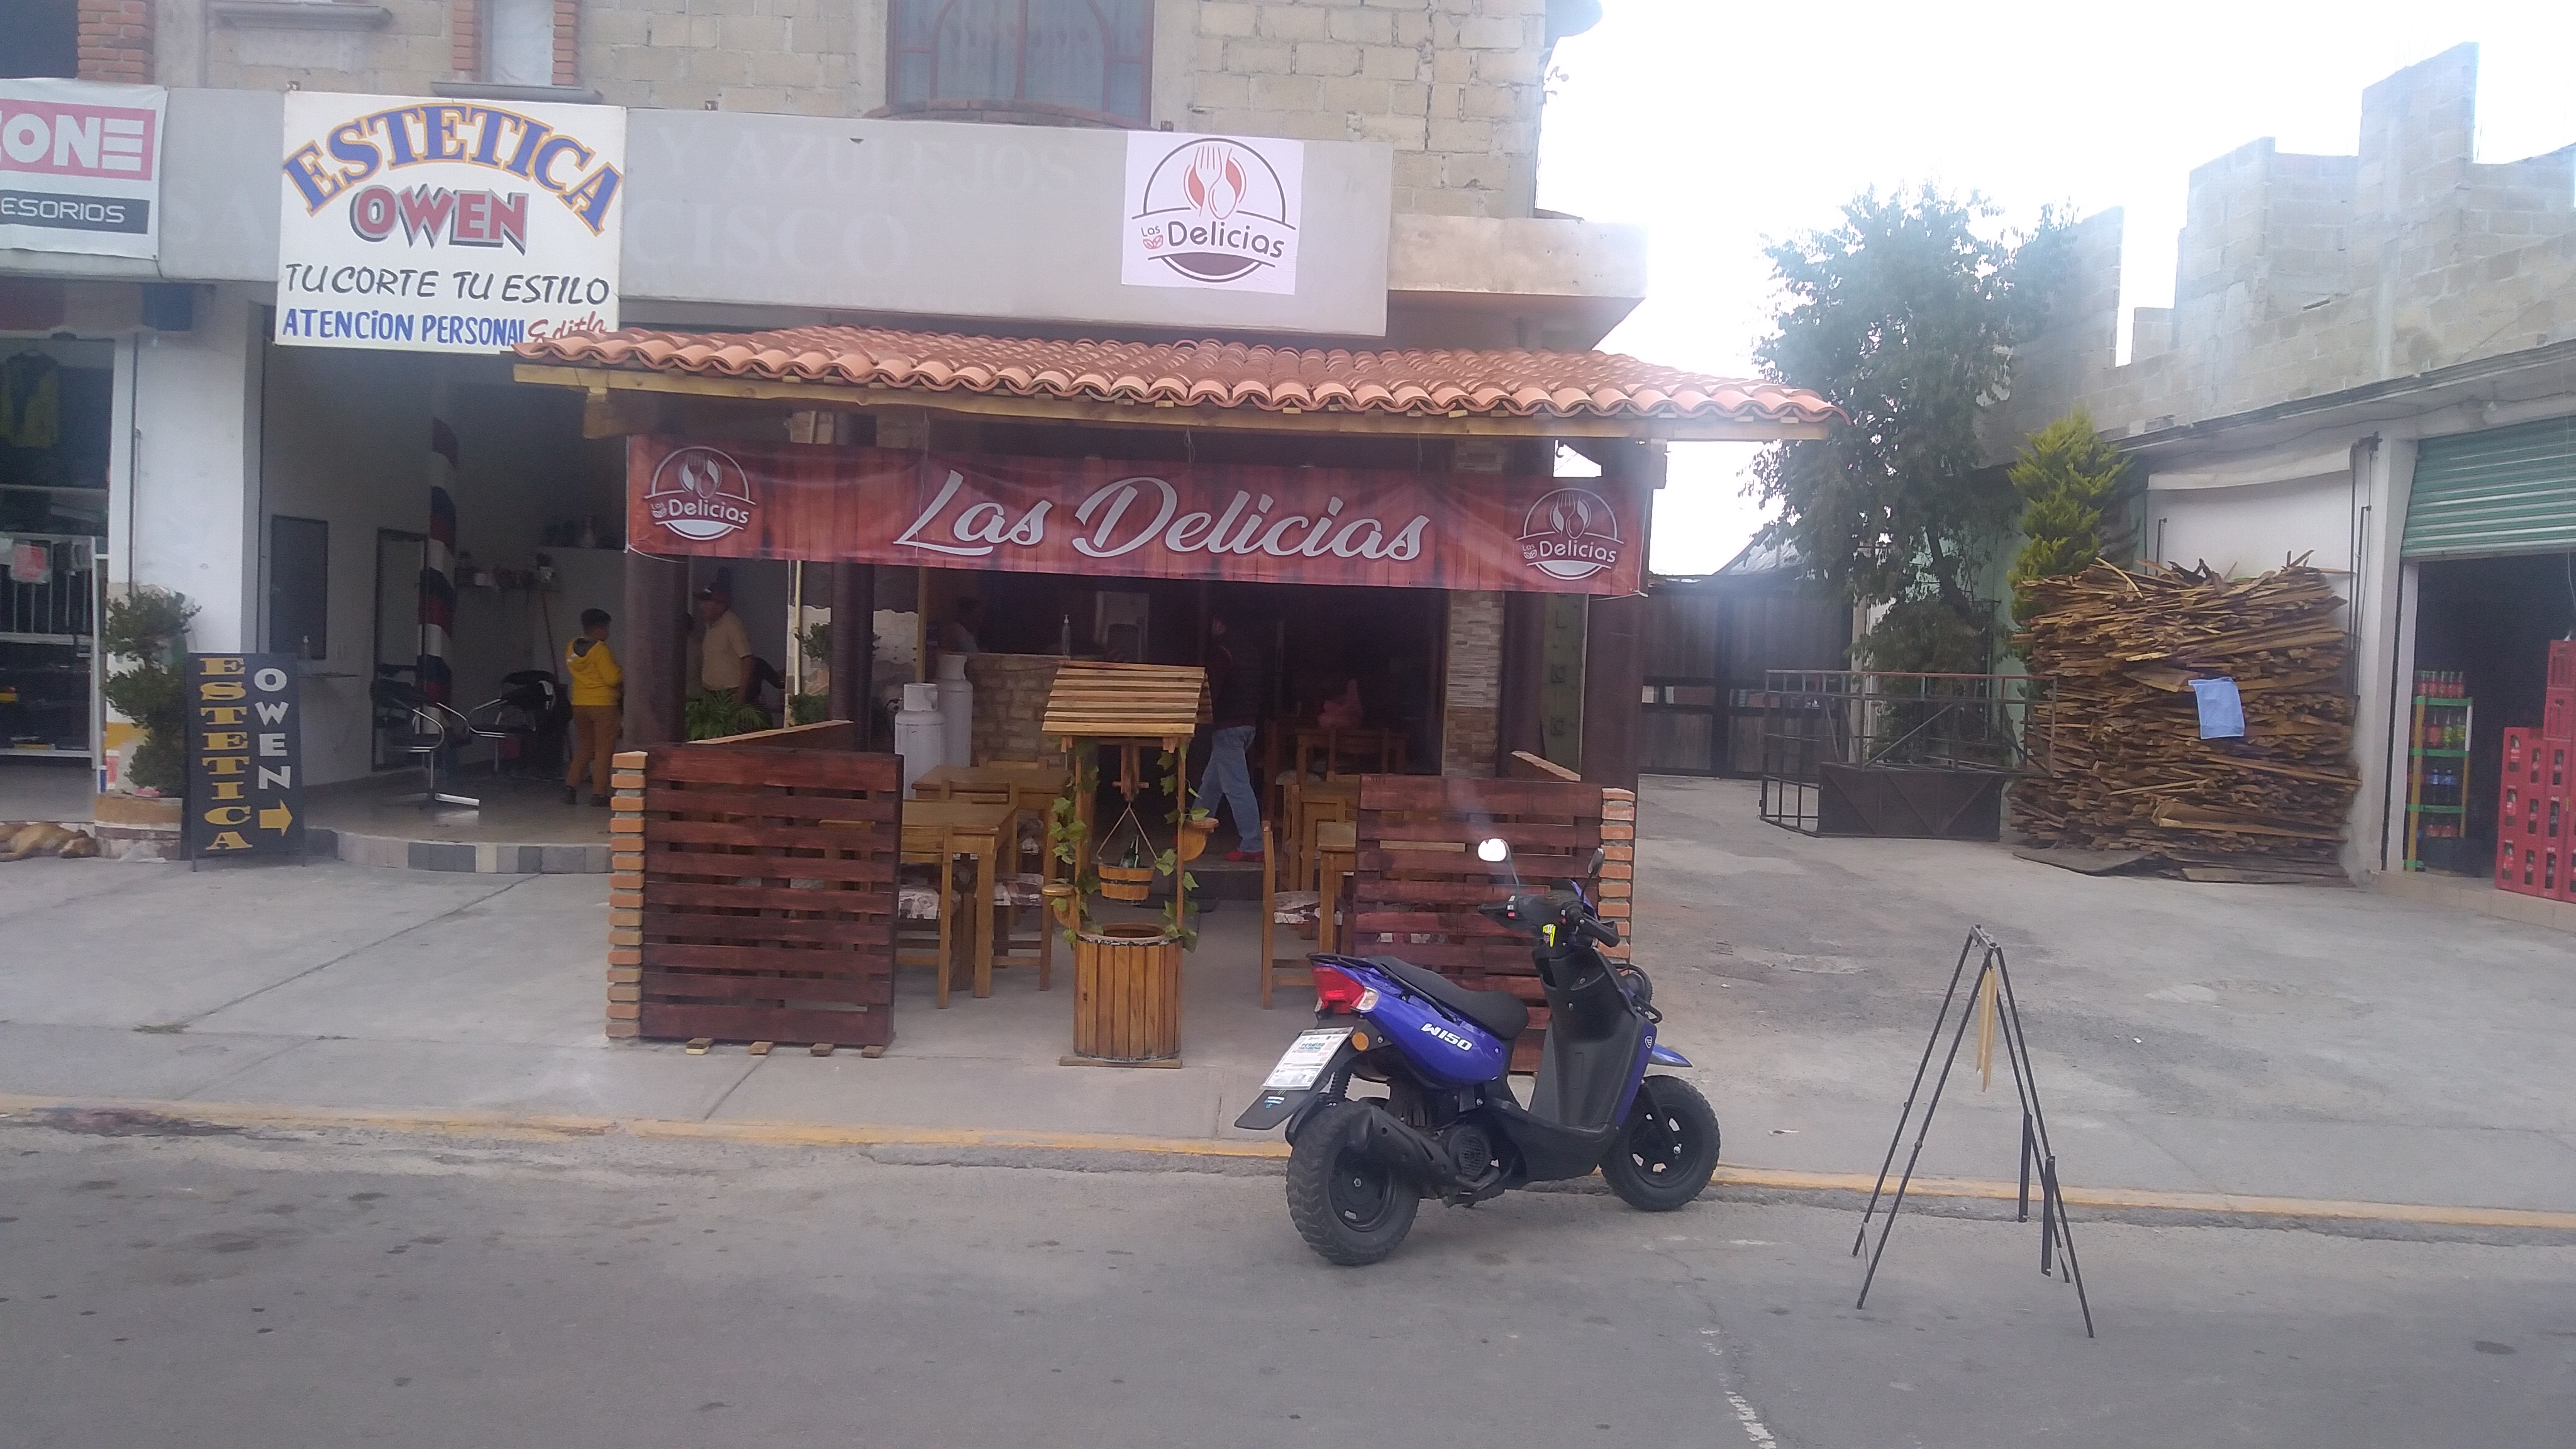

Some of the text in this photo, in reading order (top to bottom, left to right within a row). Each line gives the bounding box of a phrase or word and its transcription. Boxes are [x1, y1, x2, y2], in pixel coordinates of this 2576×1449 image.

[0, 111, 145, 172] ONE
[281, 103, 624, 237] ESTETICA
[350, 184, 529, 256] OWEN
[1141, 221, 1285, 258] Las Delicias
[453, 271, 494, 300] TU
[501, 275, 609, 304] ESTILO
[669, 499, 750, 524] Delicias
[893, 469, 1431, 561] Las Delicias
[1540, 540, 1617, 563] Delicias
[199, 657, 253, 850] ESTETICA
[253, 668, 291, 789] OWEN
